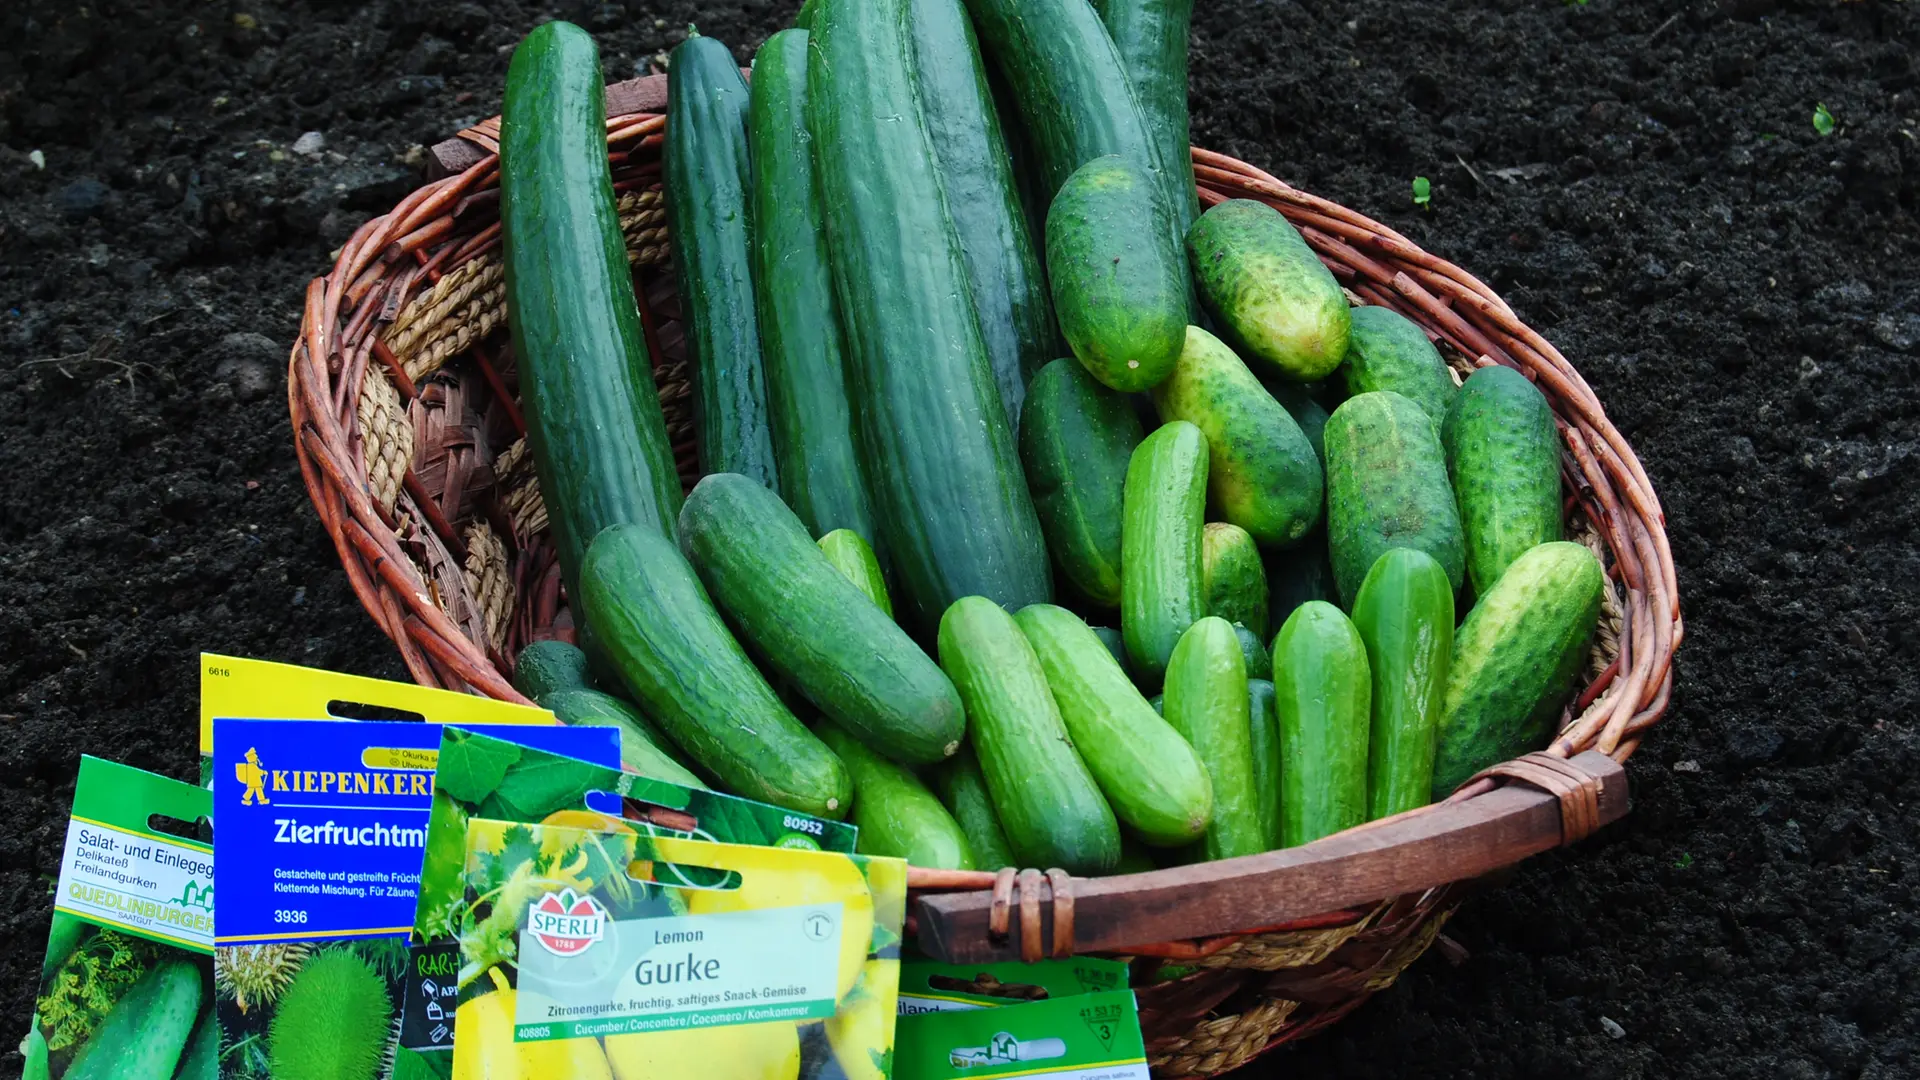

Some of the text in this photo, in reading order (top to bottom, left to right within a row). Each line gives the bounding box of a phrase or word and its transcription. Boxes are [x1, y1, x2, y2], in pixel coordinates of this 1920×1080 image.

[208, 666, 230, 677] 6616
[402, 750, 429, 762] Okurka
[783, 815, 824, 836] 80952
[76, 847, 129, 868] Delikateß
[79, 829, 214, 879] Salat- und Einlegeg
[74, 860, 158, 890] Freilandgurken
[273, 868, 327, 881] Gestachelte
[328, 871, 345, 881] und
[347, 872, 390, 884] gestreifte
[273, 882, 418, 899] Kletternde Mischung. Für Zäune,
[117, 911, 152, 926] SAATGUT
[274, 909, 308, 924] 3936
[534, 912, 598, 935] SPERLI
[654, 929, 704, 945] Lemon
[635, 952, 721, 986] Gurke
[547, 984, 807, 1017] Zitronengurke, fruchtig, saftiges Snack-Gemüse
[1079, 1007, 1091, 1017] 41
[518, 1026, 550, 1038] 408805
[1100, 1025, 1111, 1041] 3
